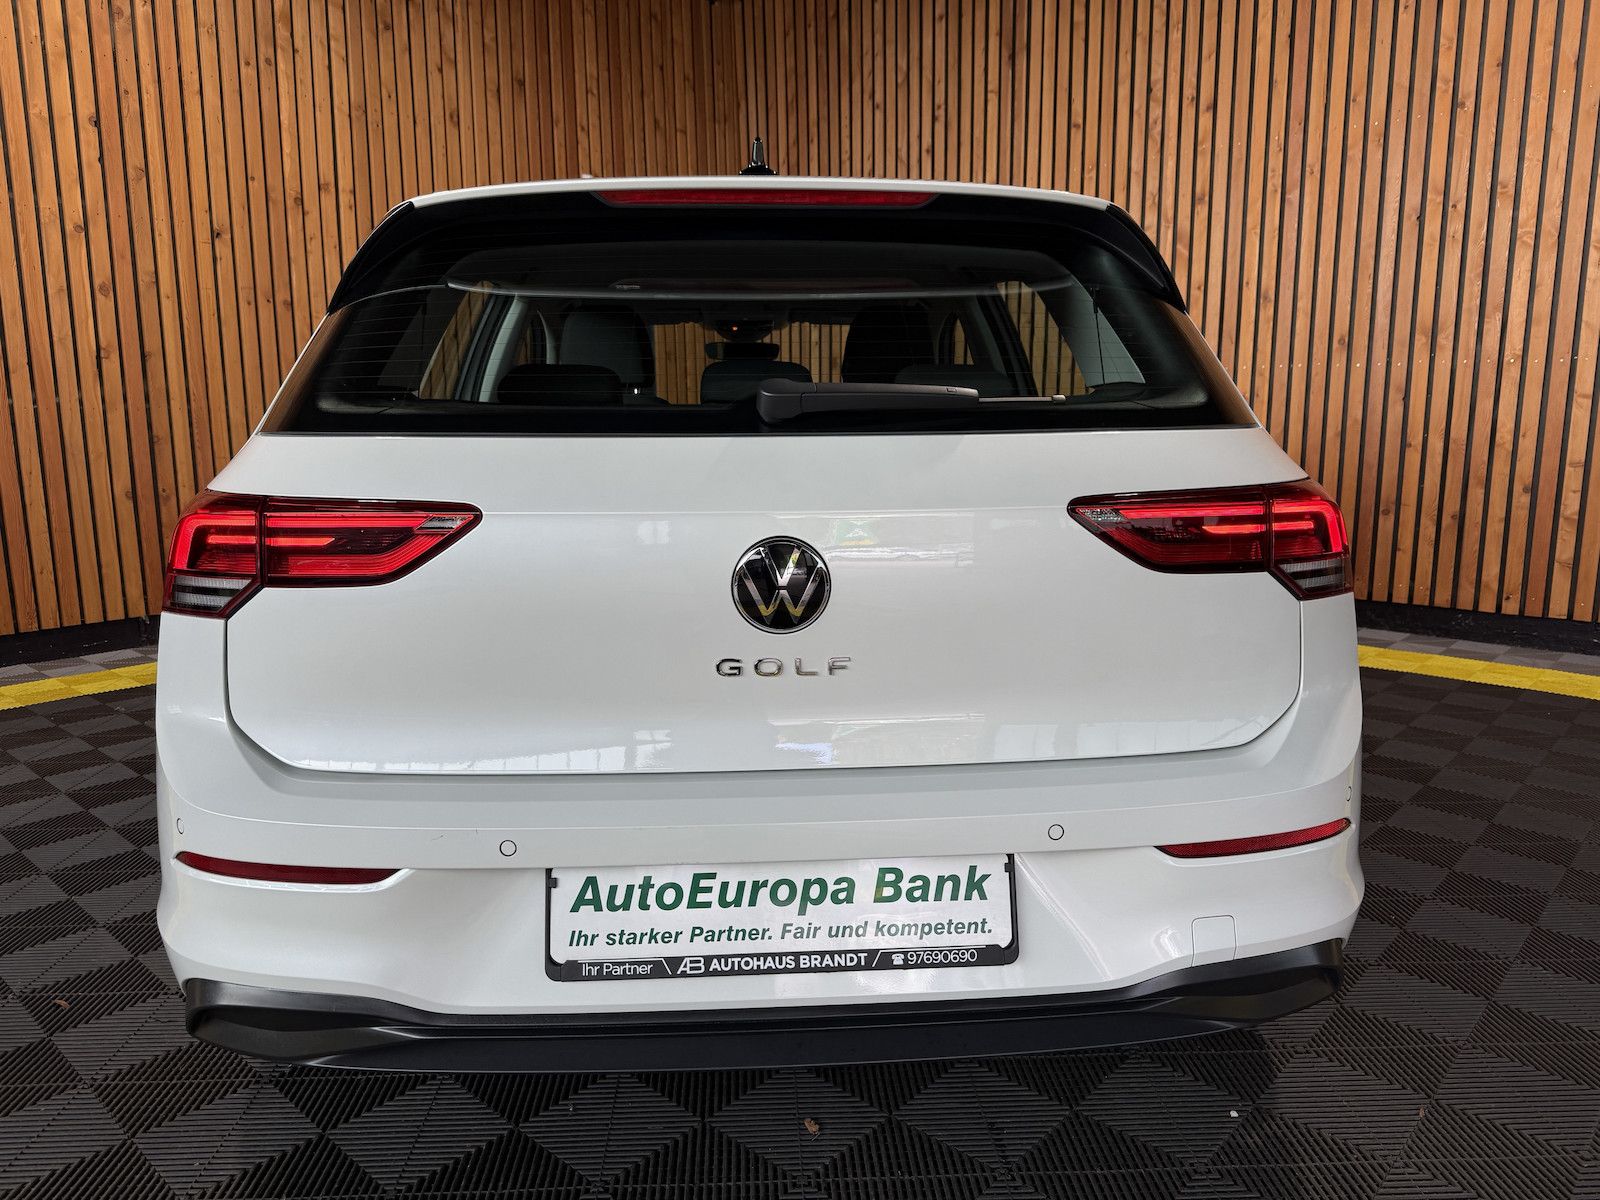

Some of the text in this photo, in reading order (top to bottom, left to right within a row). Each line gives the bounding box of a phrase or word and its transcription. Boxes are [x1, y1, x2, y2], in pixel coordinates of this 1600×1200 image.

[716, 657, 851, 677] GOLF
[569, 865, 992, 916] AutoEuropa Bank
[568, 917, 993, 947] Ihr starker Partner. Fair und kompetent.
[709, 955, 796, 972] AUTOHAUS
[800, 952, 868, 969] BRANDT
[907, 949, 978, 965] 97690690
[582, 962, 653, 976] Ihr Partner
